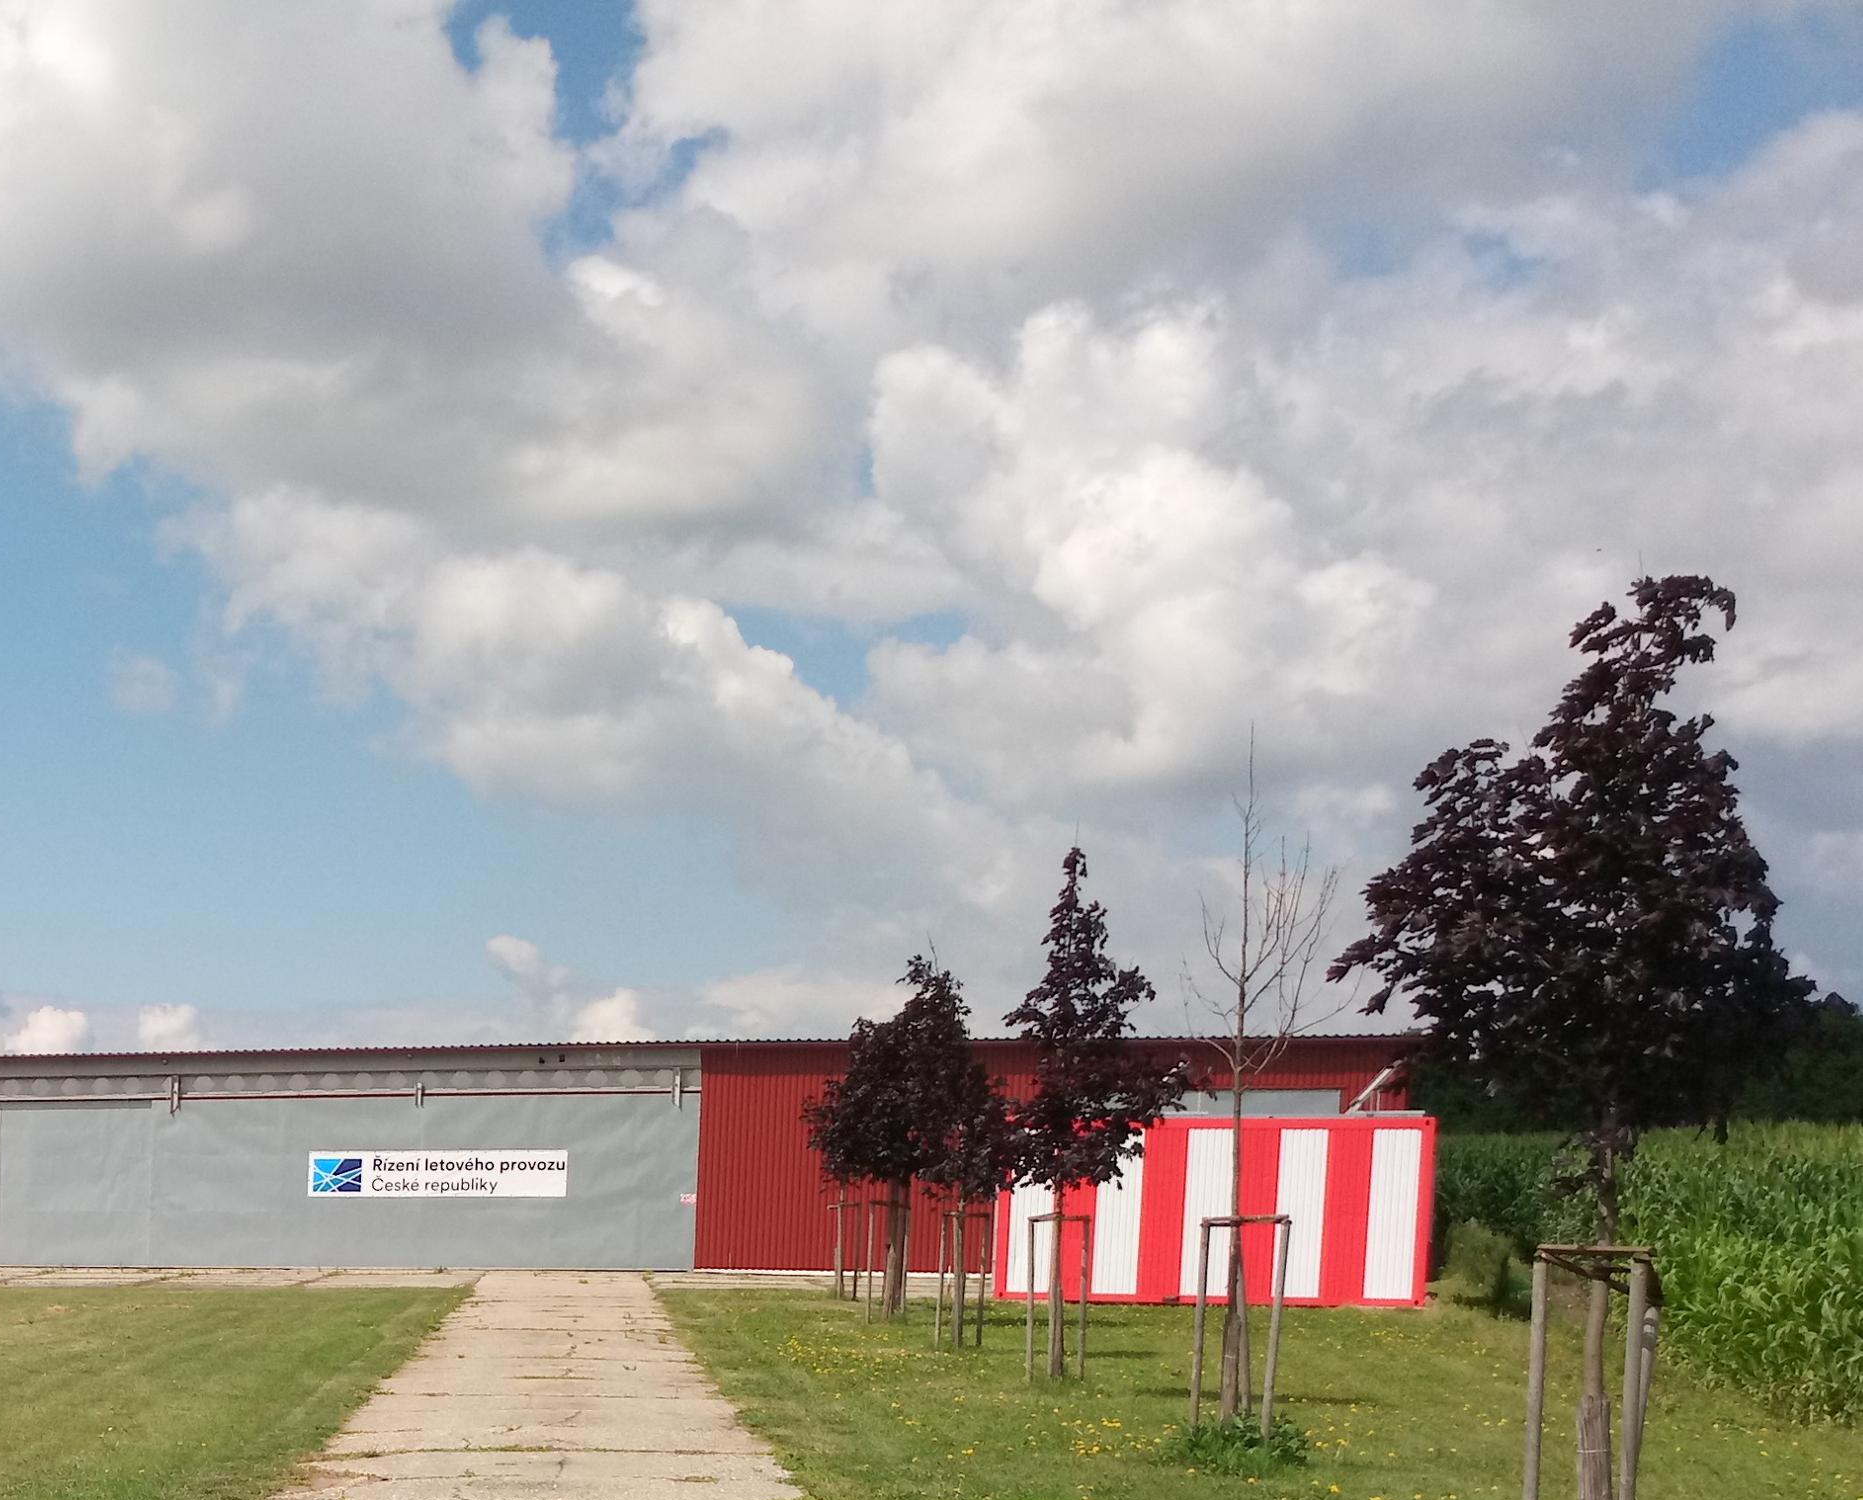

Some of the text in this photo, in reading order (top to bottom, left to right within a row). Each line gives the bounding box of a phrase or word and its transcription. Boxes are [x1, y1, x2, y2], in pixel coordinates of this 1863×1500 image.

[372, 1155, 565, 1173] Řízení letového provozu
[372, 1175, 498, 1193] České republiky
